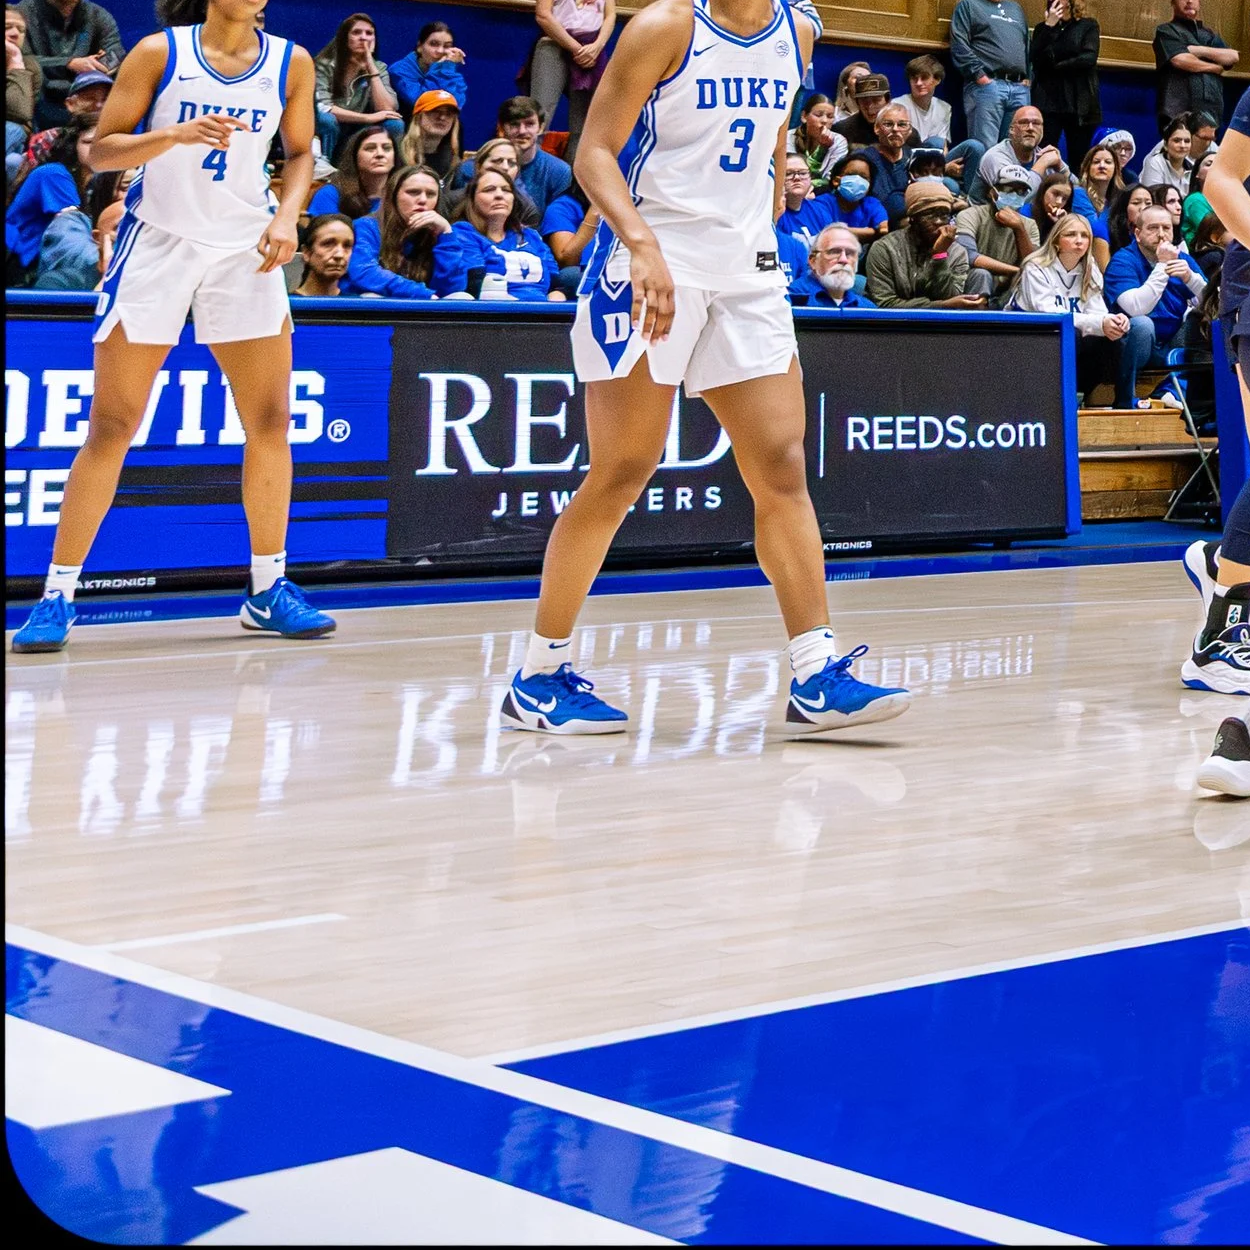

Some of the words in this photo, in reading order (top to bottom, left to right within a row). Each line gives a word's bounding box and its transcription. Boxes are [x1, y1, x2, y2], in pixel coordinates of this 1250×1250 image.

[696, 77, 788, 110] DUKE
[719, 118, 755, 172] 3
[202, 148, 227, 182] 4
[602, 312, 630, 344] D
[415, 372, 732, 476] RED
[846, 414, 1046, 450] REEDS.com
[491, 486, 722, 518] JEWERS
[823, 540, 873, 551] KTRONICS
[74, 576, 157, 590] AKTRONICS
